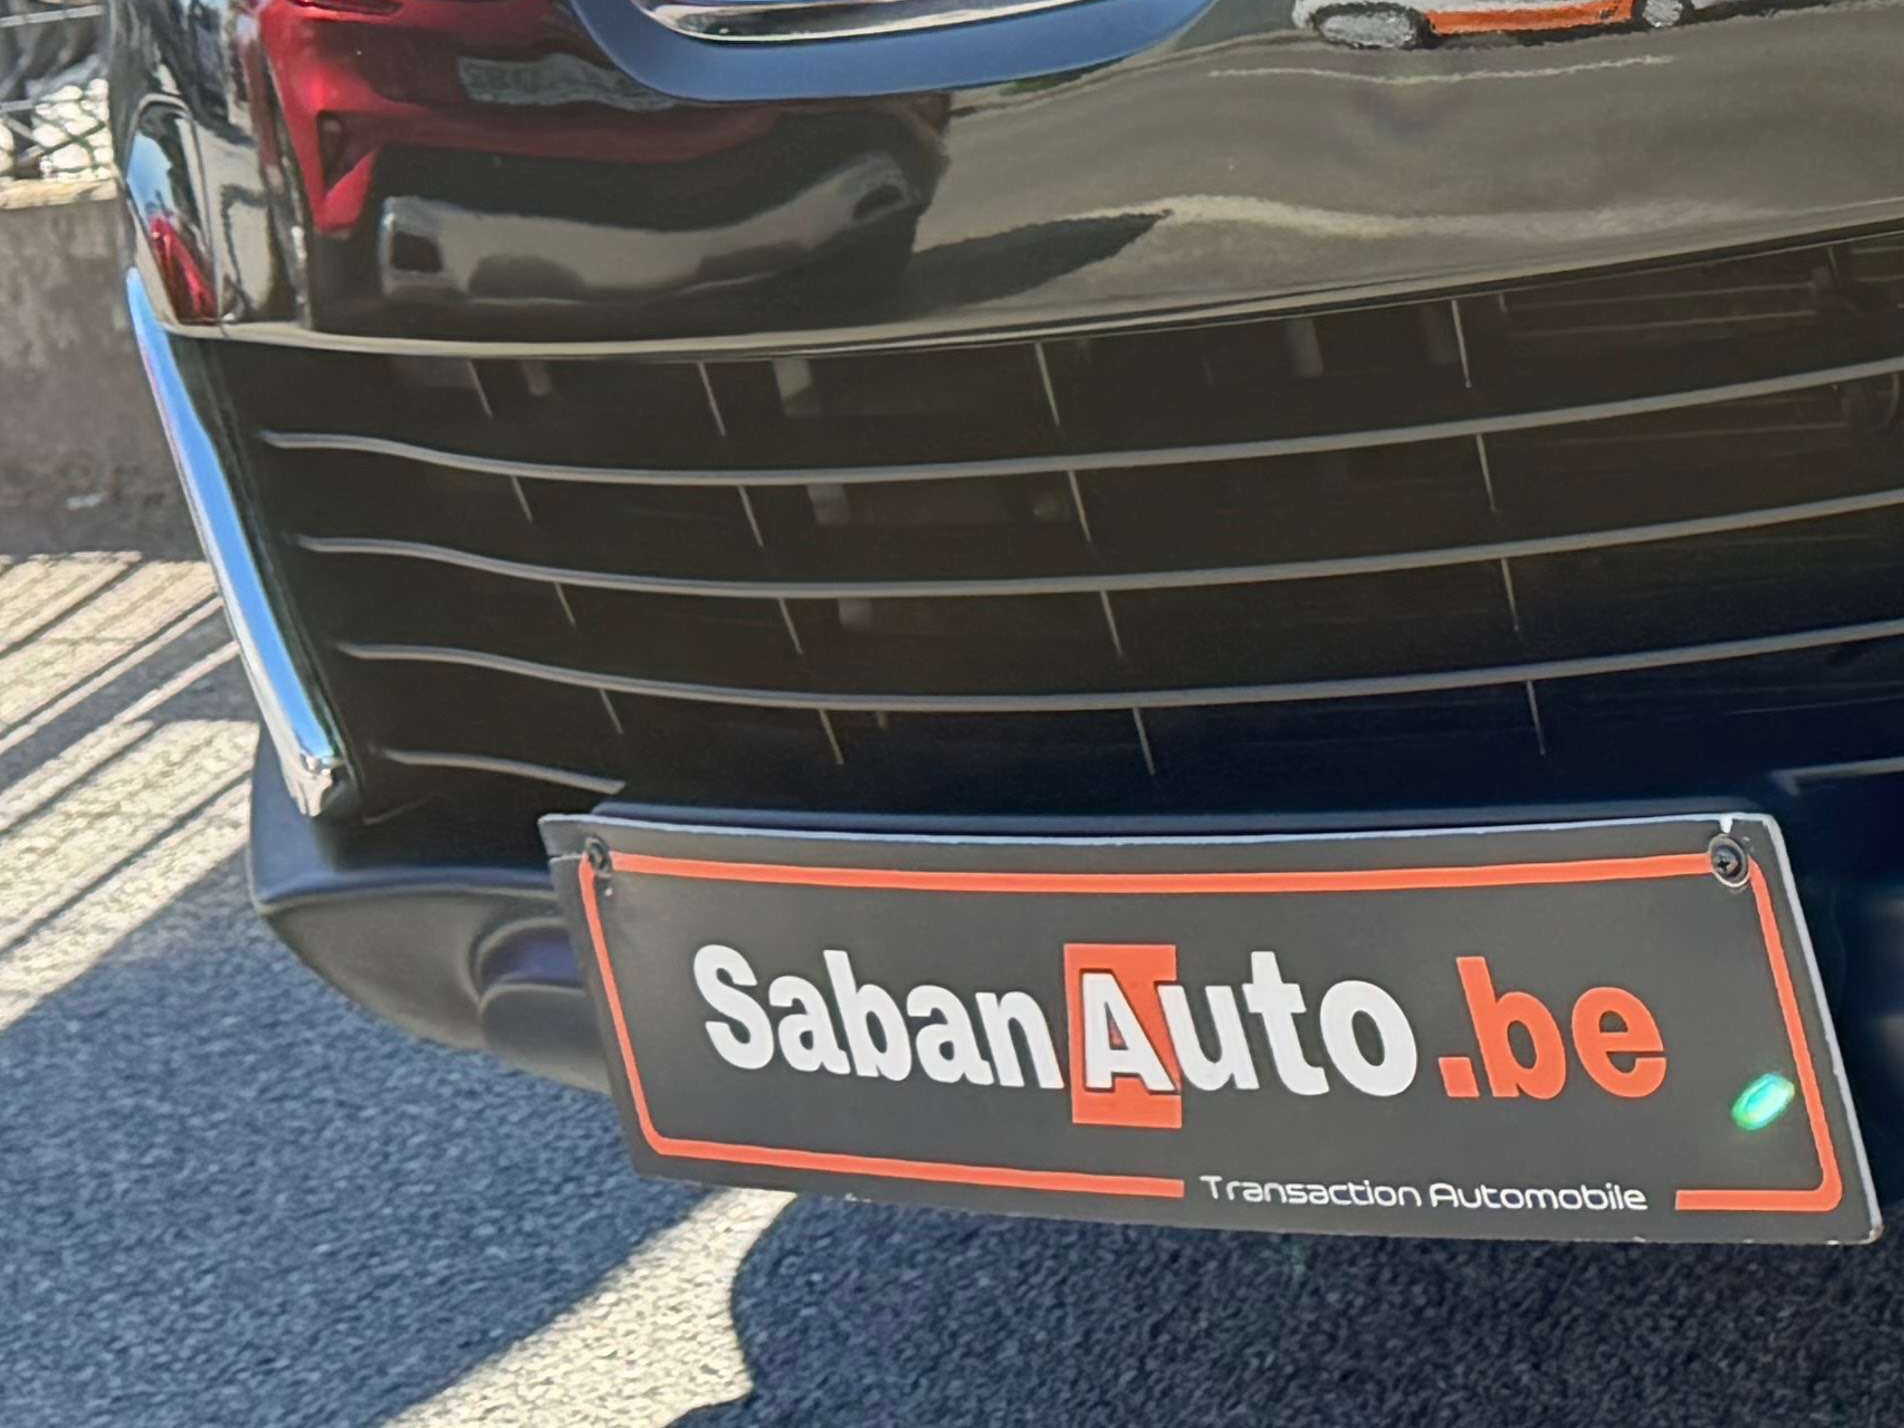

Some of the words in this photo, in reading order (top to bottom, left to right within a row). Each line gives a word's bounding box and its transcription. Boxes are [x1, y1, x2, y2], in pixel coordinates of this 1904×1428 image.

[691, 944, 1668, 1101] SabanAuto.be
[1200, 1174, 1423, 1212] Transaction
[1430, 1182, 1649, 1213] Automobile
